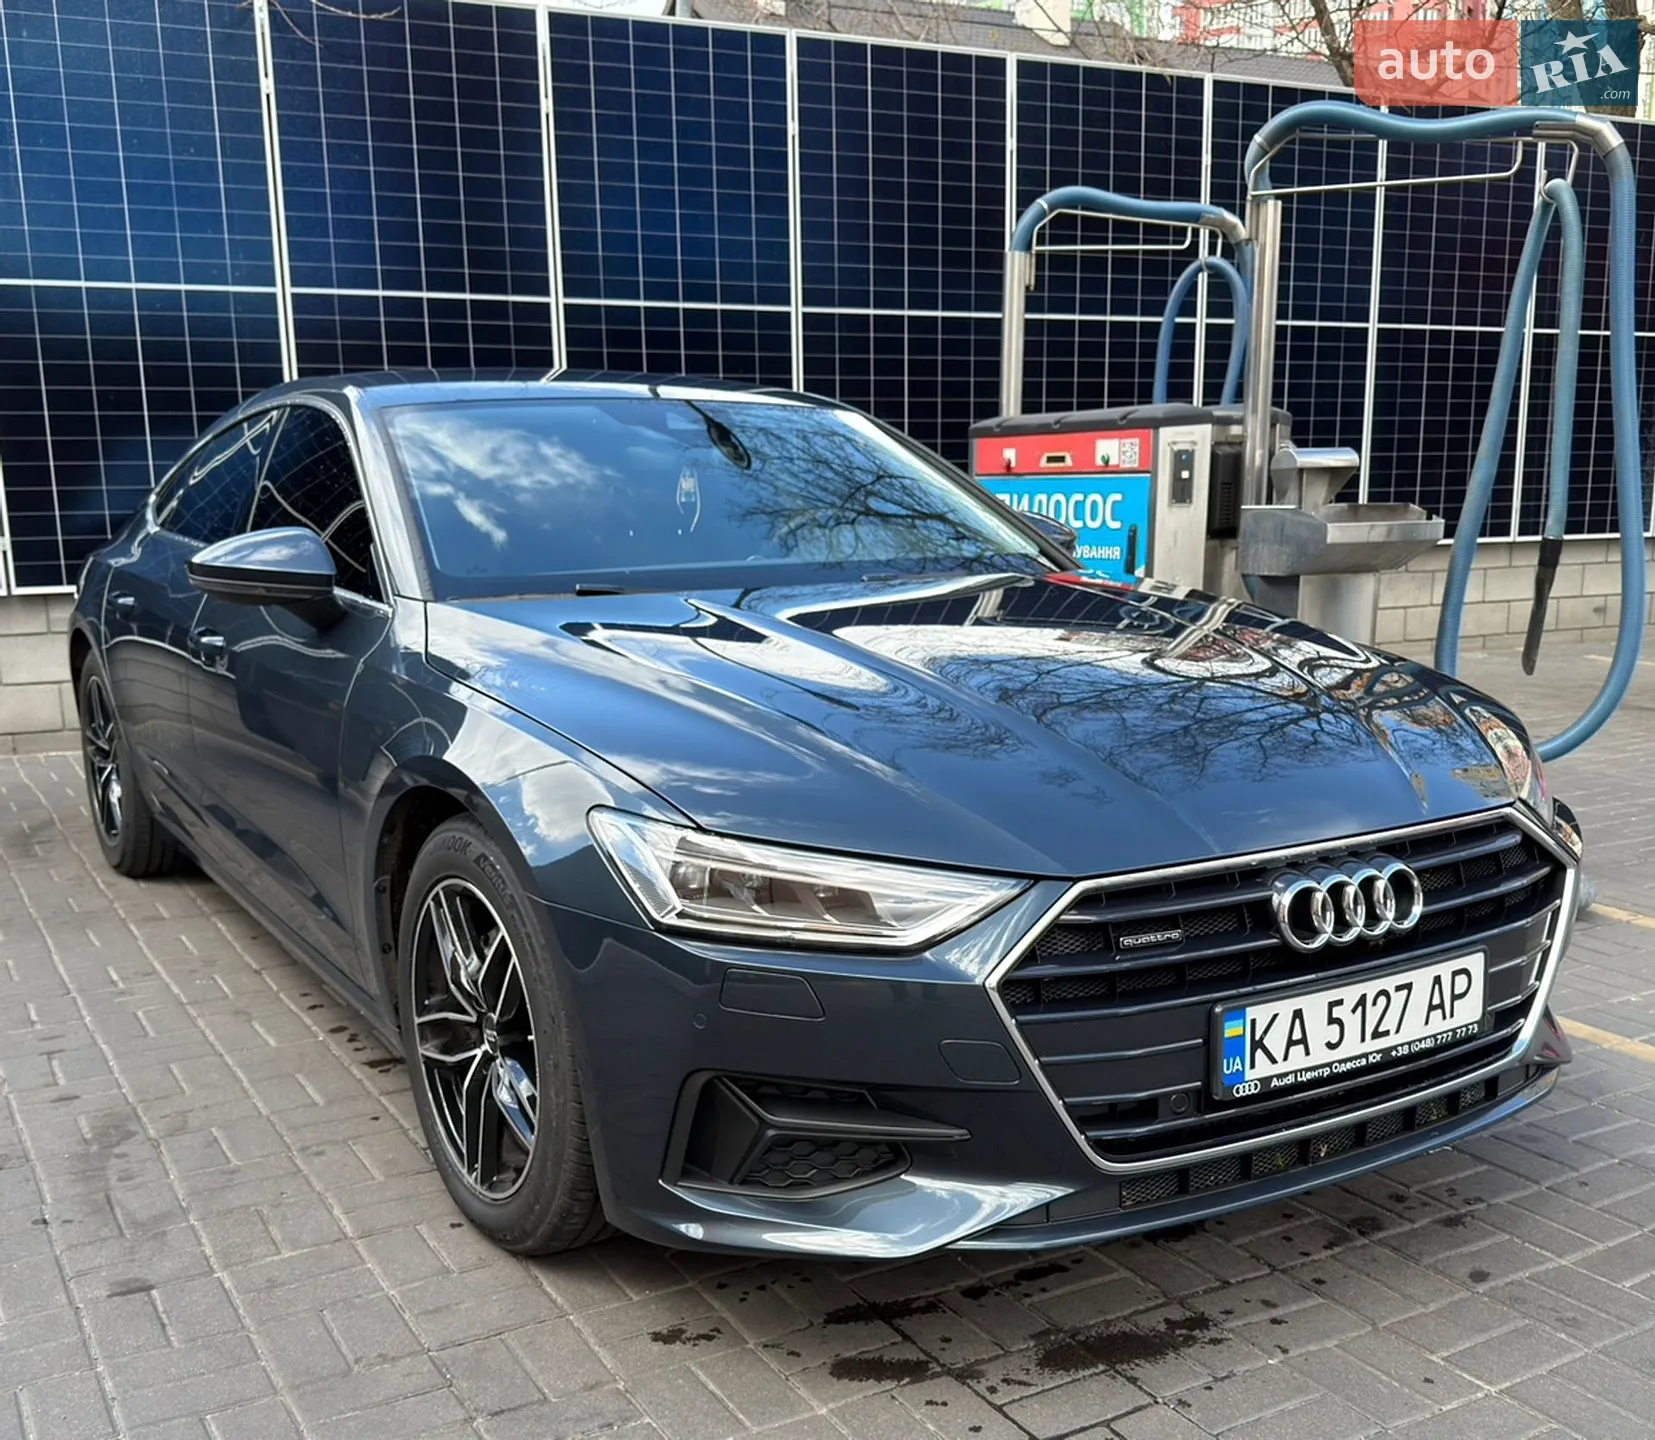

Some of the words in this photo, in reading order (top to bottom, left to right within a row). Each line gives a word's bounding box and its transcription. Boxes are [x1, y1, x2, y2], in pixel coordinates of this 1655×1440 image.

[1122, 932, 1180, 947] quattro
[1249, 1008, 1311, 1070] KA
[1324, 981, 1414, 1050] 5127
[1424, 967, 1473, 1026] AP
[1223, 1058, 1243, 1075] UA
[1270, 1073, 1295, 1088] Audi
[1297, 1066, 1330, 1081] Центр
[1332, 1057, 1367, 1073] Одесса
[1368, 1053, 1382, 1064] Юг
[1390, 1044, 1409, 1057] +38
[1410, 1037, 1435, 1053] (048)
[1436, 1031, 1453, 1045] 777
